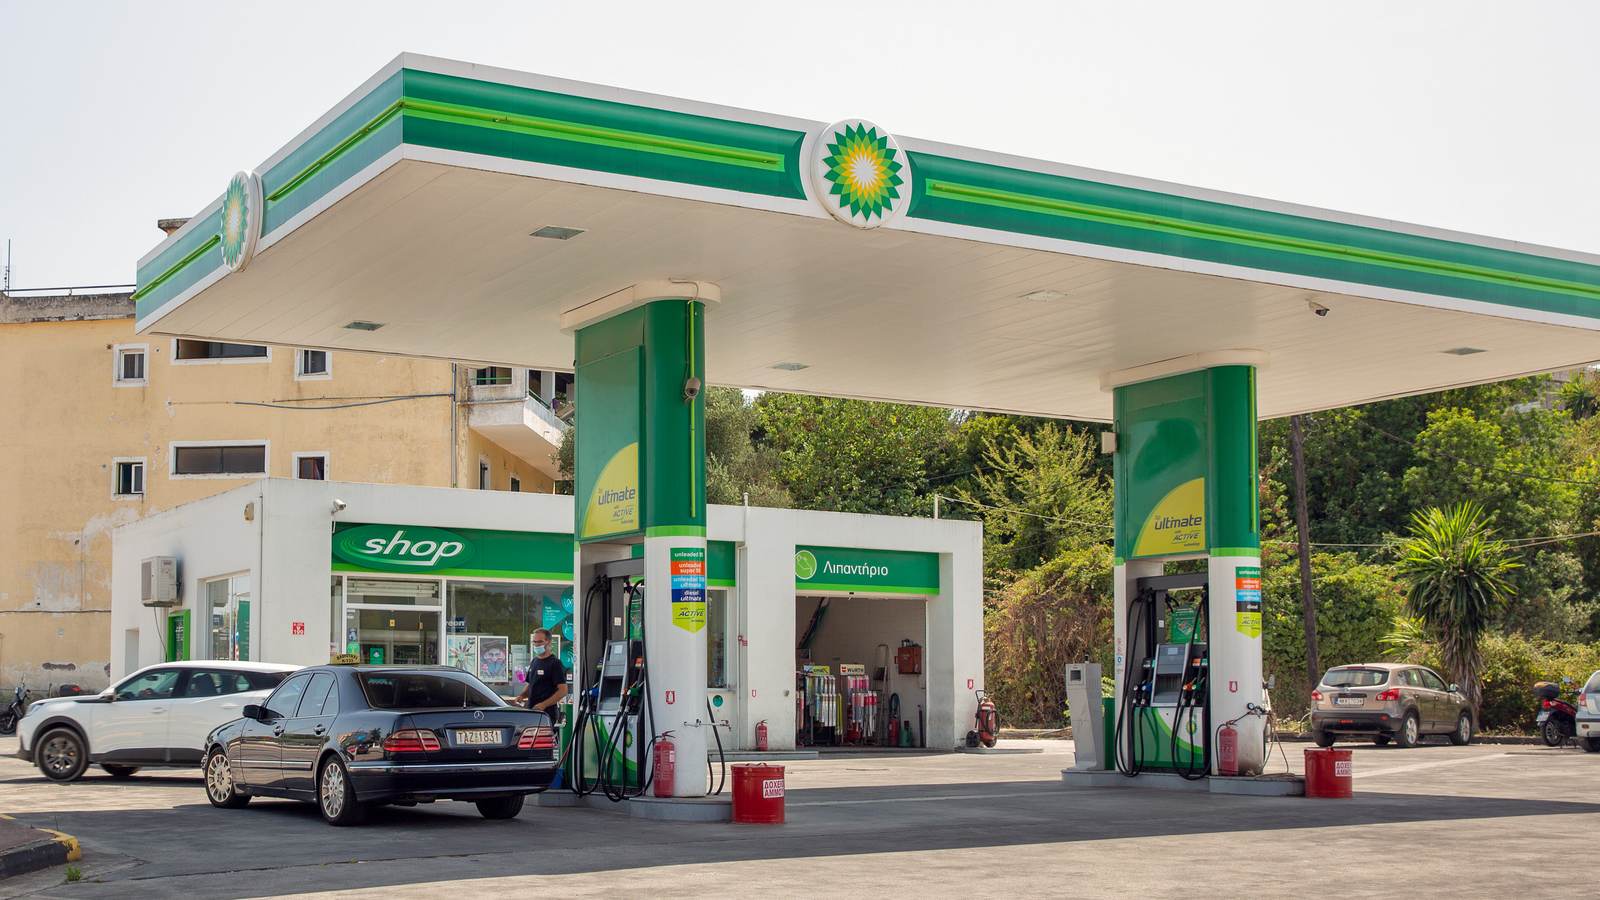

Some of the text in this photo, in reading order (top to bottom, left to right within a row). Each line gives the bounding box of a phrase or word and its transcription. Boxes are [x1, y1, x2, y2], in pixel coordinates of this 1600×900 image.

[598, 486, 635, 505] ultimate
[1154, 514, 1202, 530] ultimate
[1173, 533, 1200, 541] ACTIVE
[363, 530, 463, 566] shop
[823, 560, 889, 579] Λιπαντήριο
